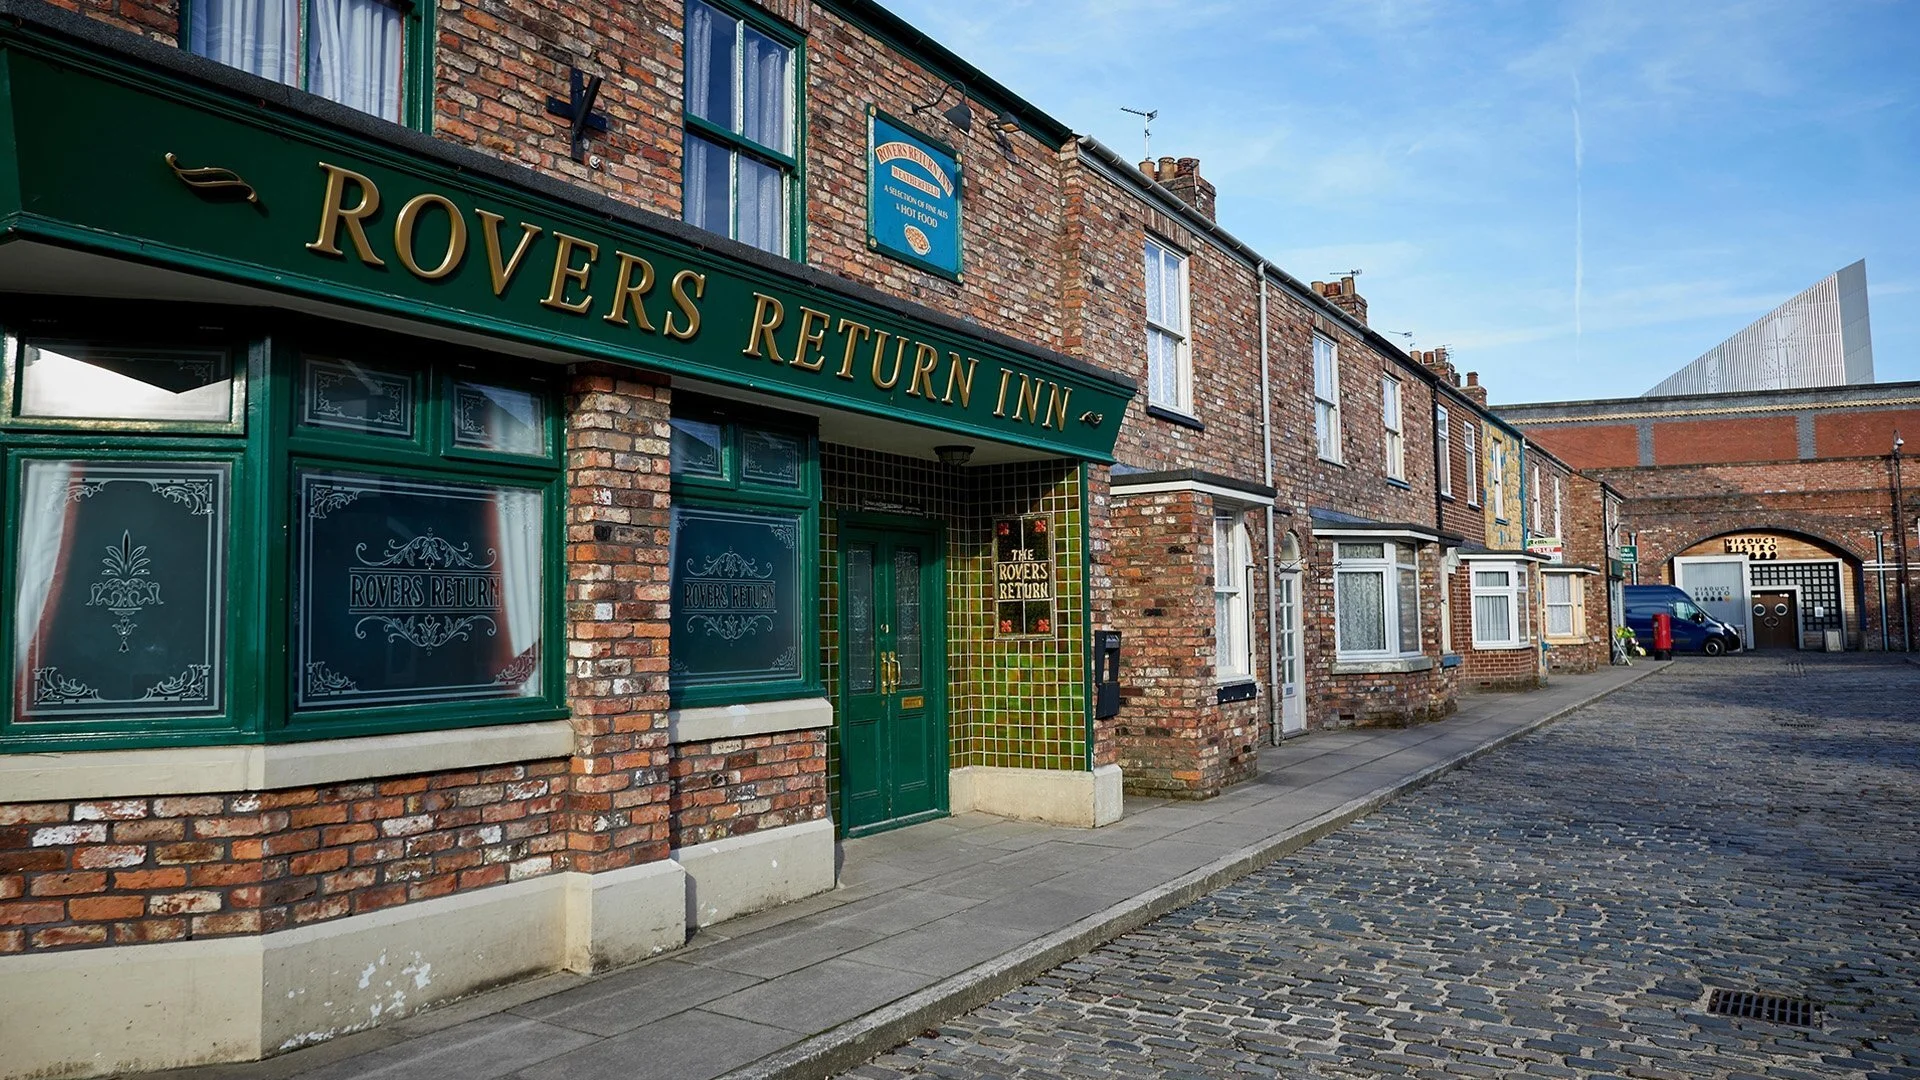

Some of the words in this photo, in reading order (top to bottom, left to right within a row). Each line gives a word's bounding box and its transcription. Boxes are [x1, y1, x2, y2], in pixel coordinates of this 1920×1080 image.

[876, 143, 907, 163] ROVERS
[907, 145, 938, 176] RETURN
[938, 171, 952, 194] INN
[893, 167, 939, 197] WEATHERFIELD
[889, 186, 917, 205] SELECTION
[917, 200, 925, 208] OF
[925, 202, 936, 215] FINE
[937, 209, 948, 219] ALES
[901, 204, 916, 218] HOT
[918, 212, 938, 228] FOOD
[305, 161, 705, 340] ROVERS
[742, 292, 980, 408] RETURN
[993, 367, 1073, 432] INN
[1011, 548, 1034, 560] THE
[1727, 544, 1776, 552] BISTRO
[999, 563, 1048, 580] ROVERS
[350, 574, 425, 607] ROVERS
[430, 575, 500, 607] RETURN
[683, 582, 729, 609] ROVERS
[731, 583, 776, 609] RETURN
[999, 582, 1049, 600] RETURN
